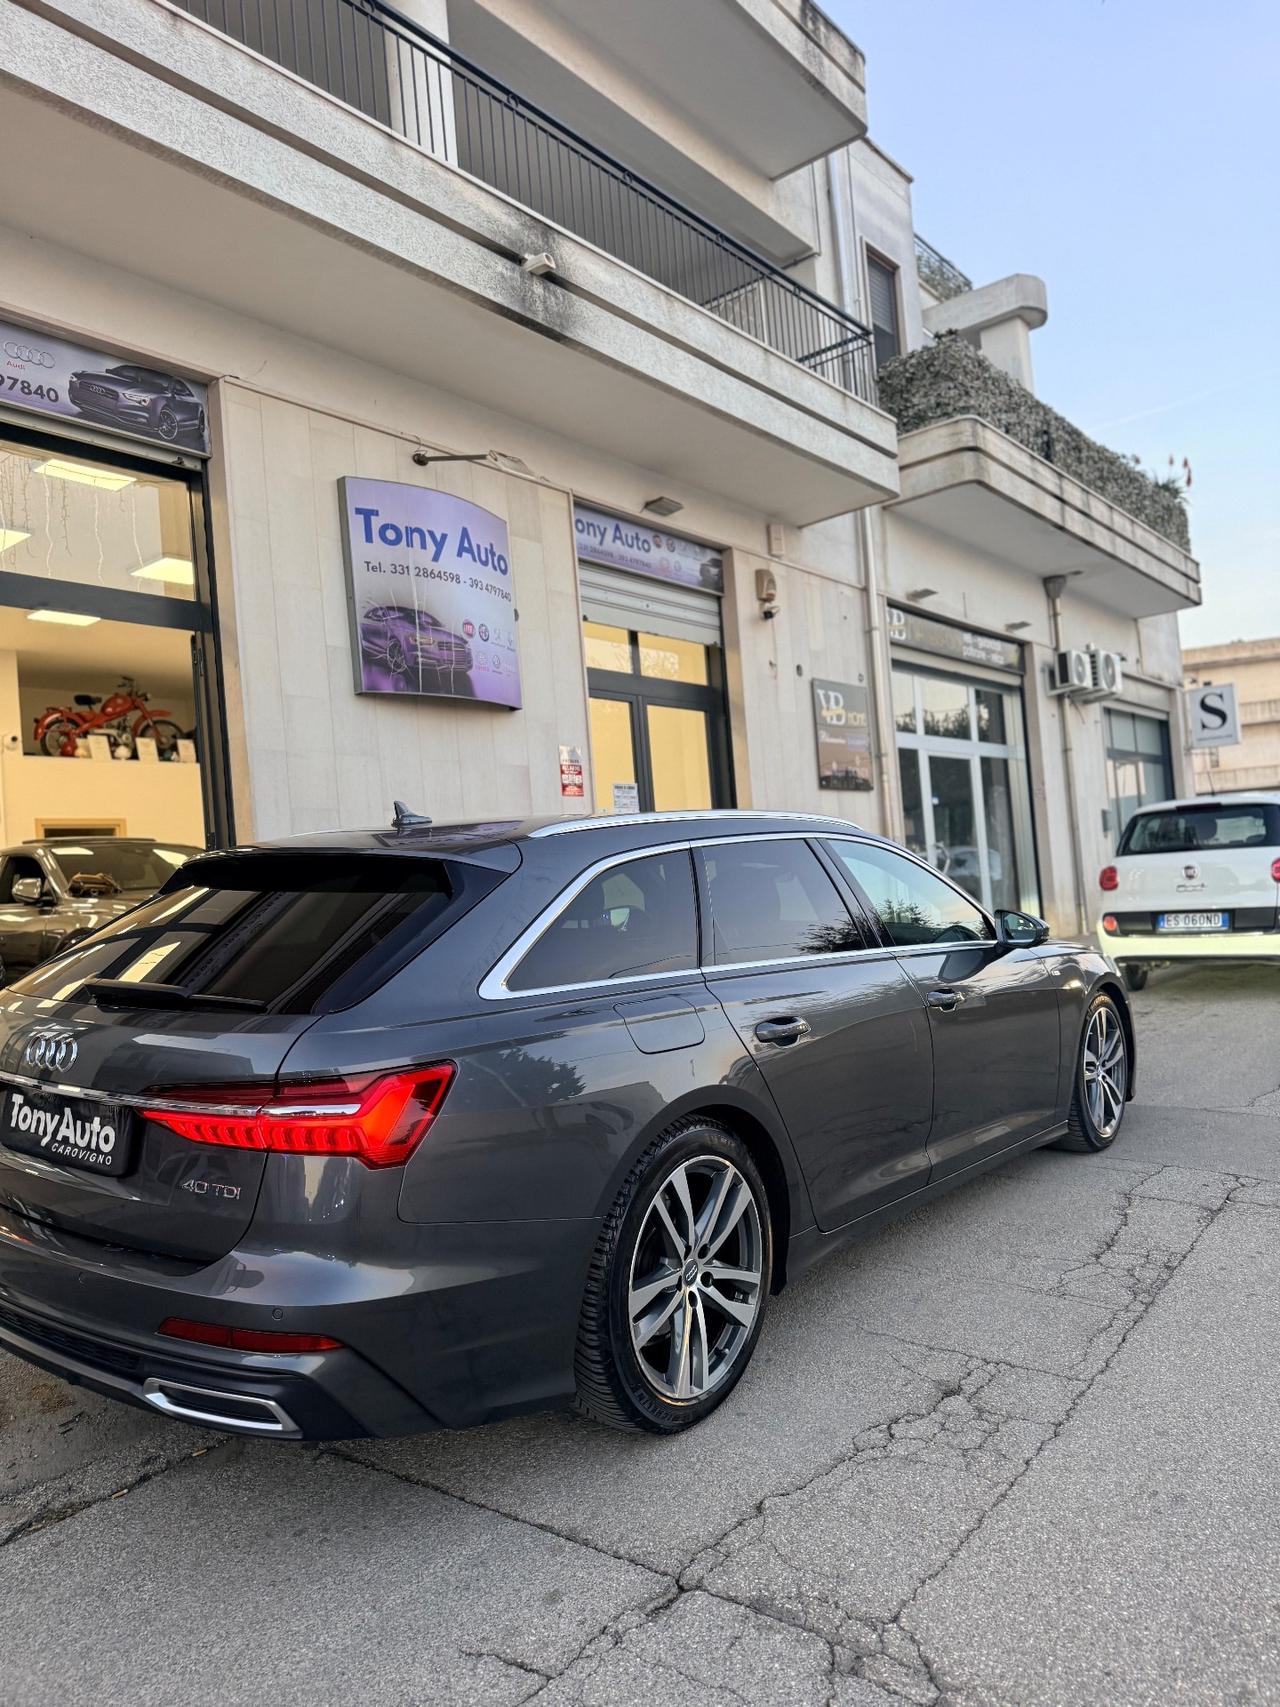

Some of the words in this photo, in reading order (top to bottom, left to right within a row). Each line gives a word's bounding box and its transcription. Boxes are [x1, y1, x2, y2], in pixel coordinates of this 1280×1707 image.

[354, 507, 448, 563] Tony
[456, 526, 509, 576] Auto
[575, 517, 607, 546] ony
[612, 523, 651, 553] Auto
[364, 561, 386, 574] Tel.
[390, 563, 411, 576] 331
[414, 566, 461, 584] 2864598
[468, 577, 484, 591] 393
[1199, 691, 1228, 732] S
[1166, 914, 1180, 926] ES
[51, 1143, 112, 1166] CAROVIGNO
[182, 1179, 208, 1194] 40
[211, 1183, 241, 1200] TDI
